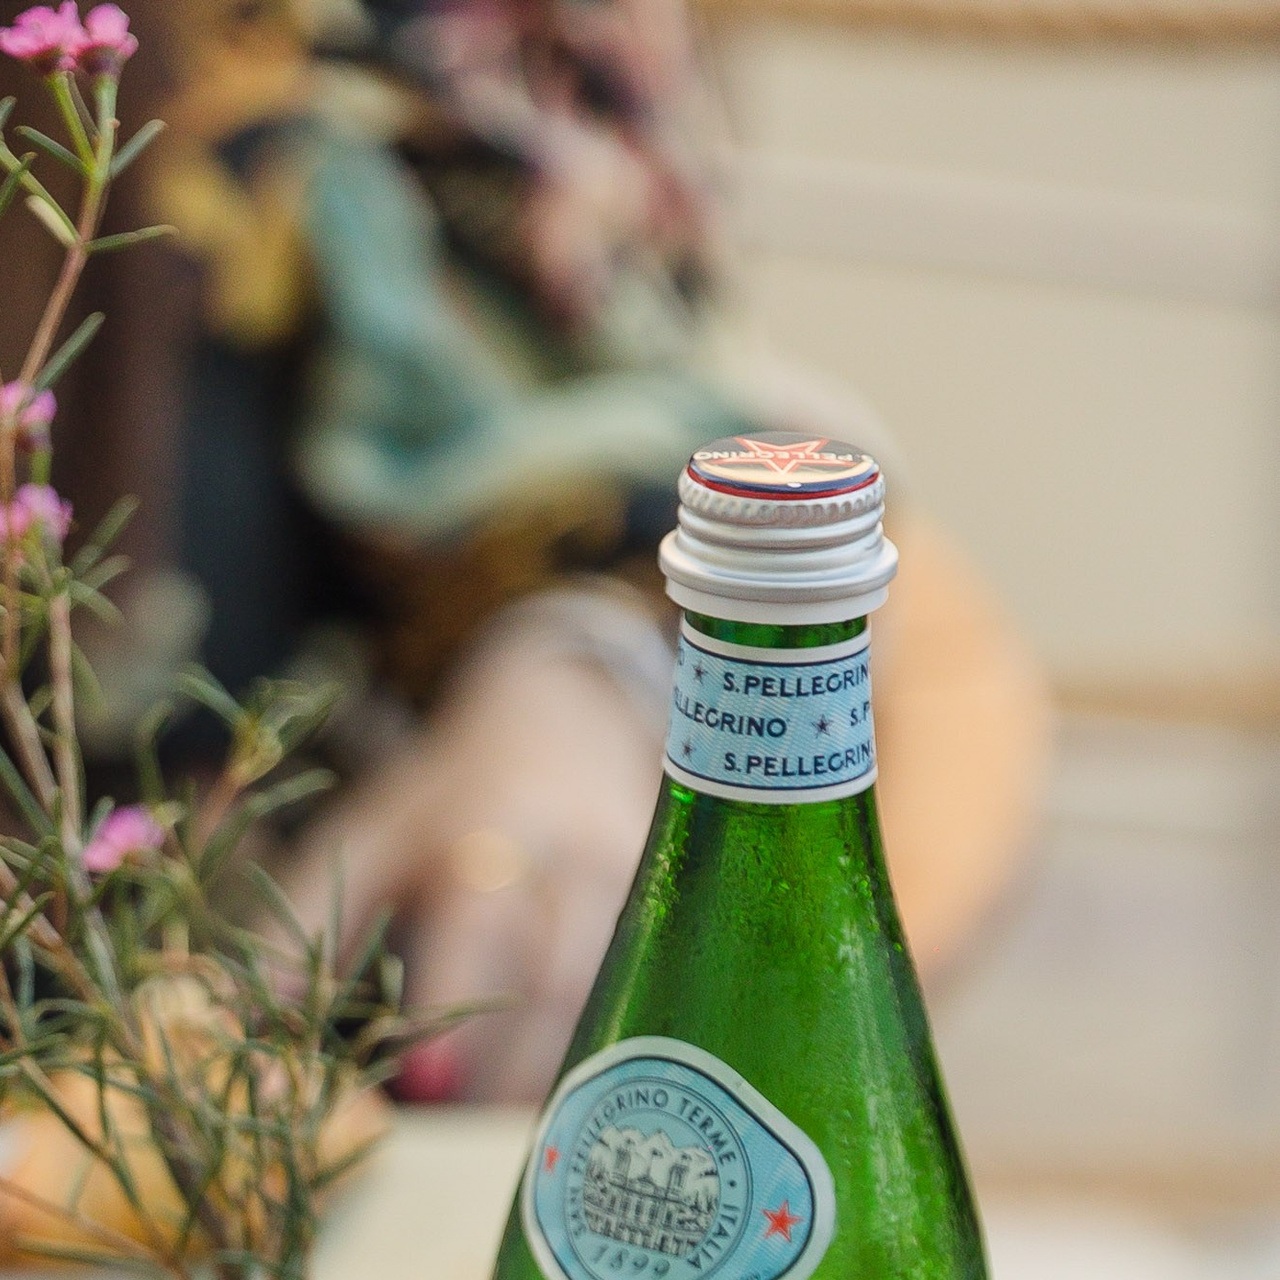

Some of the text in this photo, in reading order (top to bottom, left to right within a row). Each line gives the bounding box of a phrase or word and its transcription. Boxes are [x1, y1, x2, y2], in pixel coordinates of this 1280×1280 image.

[724, 739, 874, 777] S.PELLEGRIN
[679, 1097, 737, 1167] TERME
[687, 1203, 741, 1271] ITALIA
